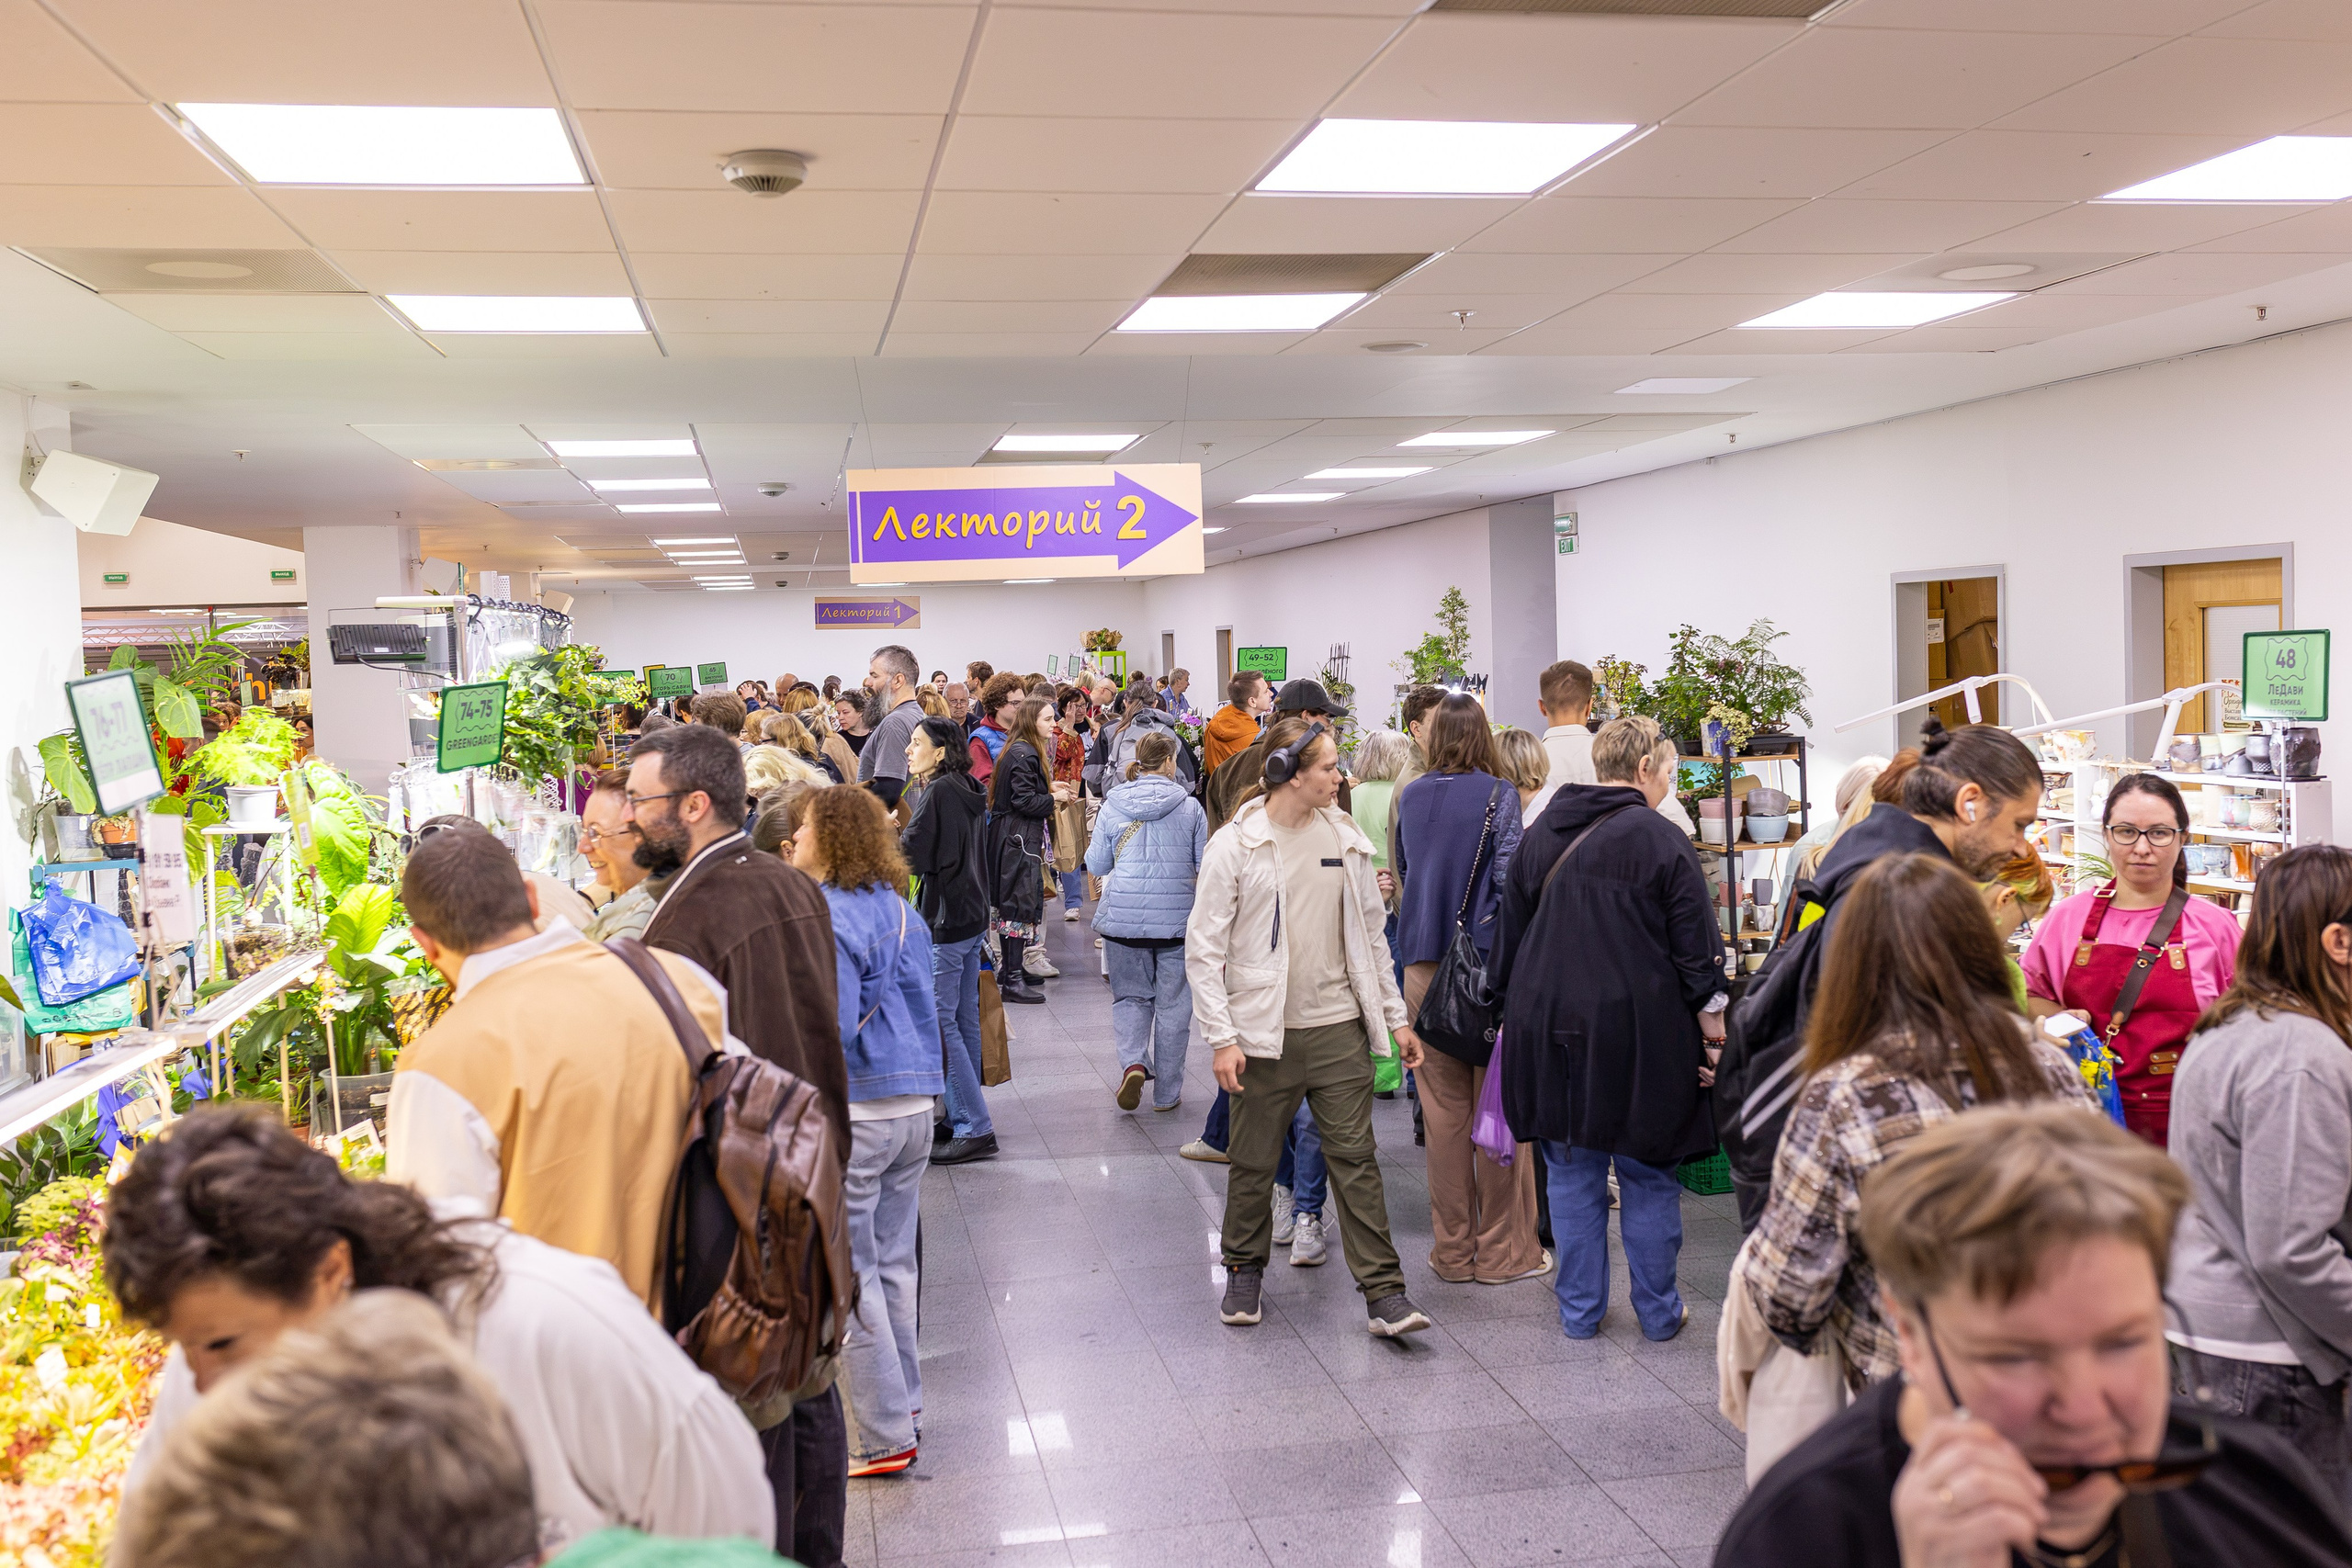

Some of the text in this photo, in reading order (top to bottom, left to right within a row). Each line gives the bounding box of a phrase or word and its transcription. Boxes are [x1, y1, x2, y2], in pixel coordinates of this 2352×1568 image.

[873, 495, 1148, 549] Лекторий 2
[821, 605, 901, 621] Лекторий 1
[1249, 653, 1274, 661] 49-52
[2276, 649, 2296, 668] 48
[665, 672, 676, 681] 70
[460, 699, 492, 720] 74-75
